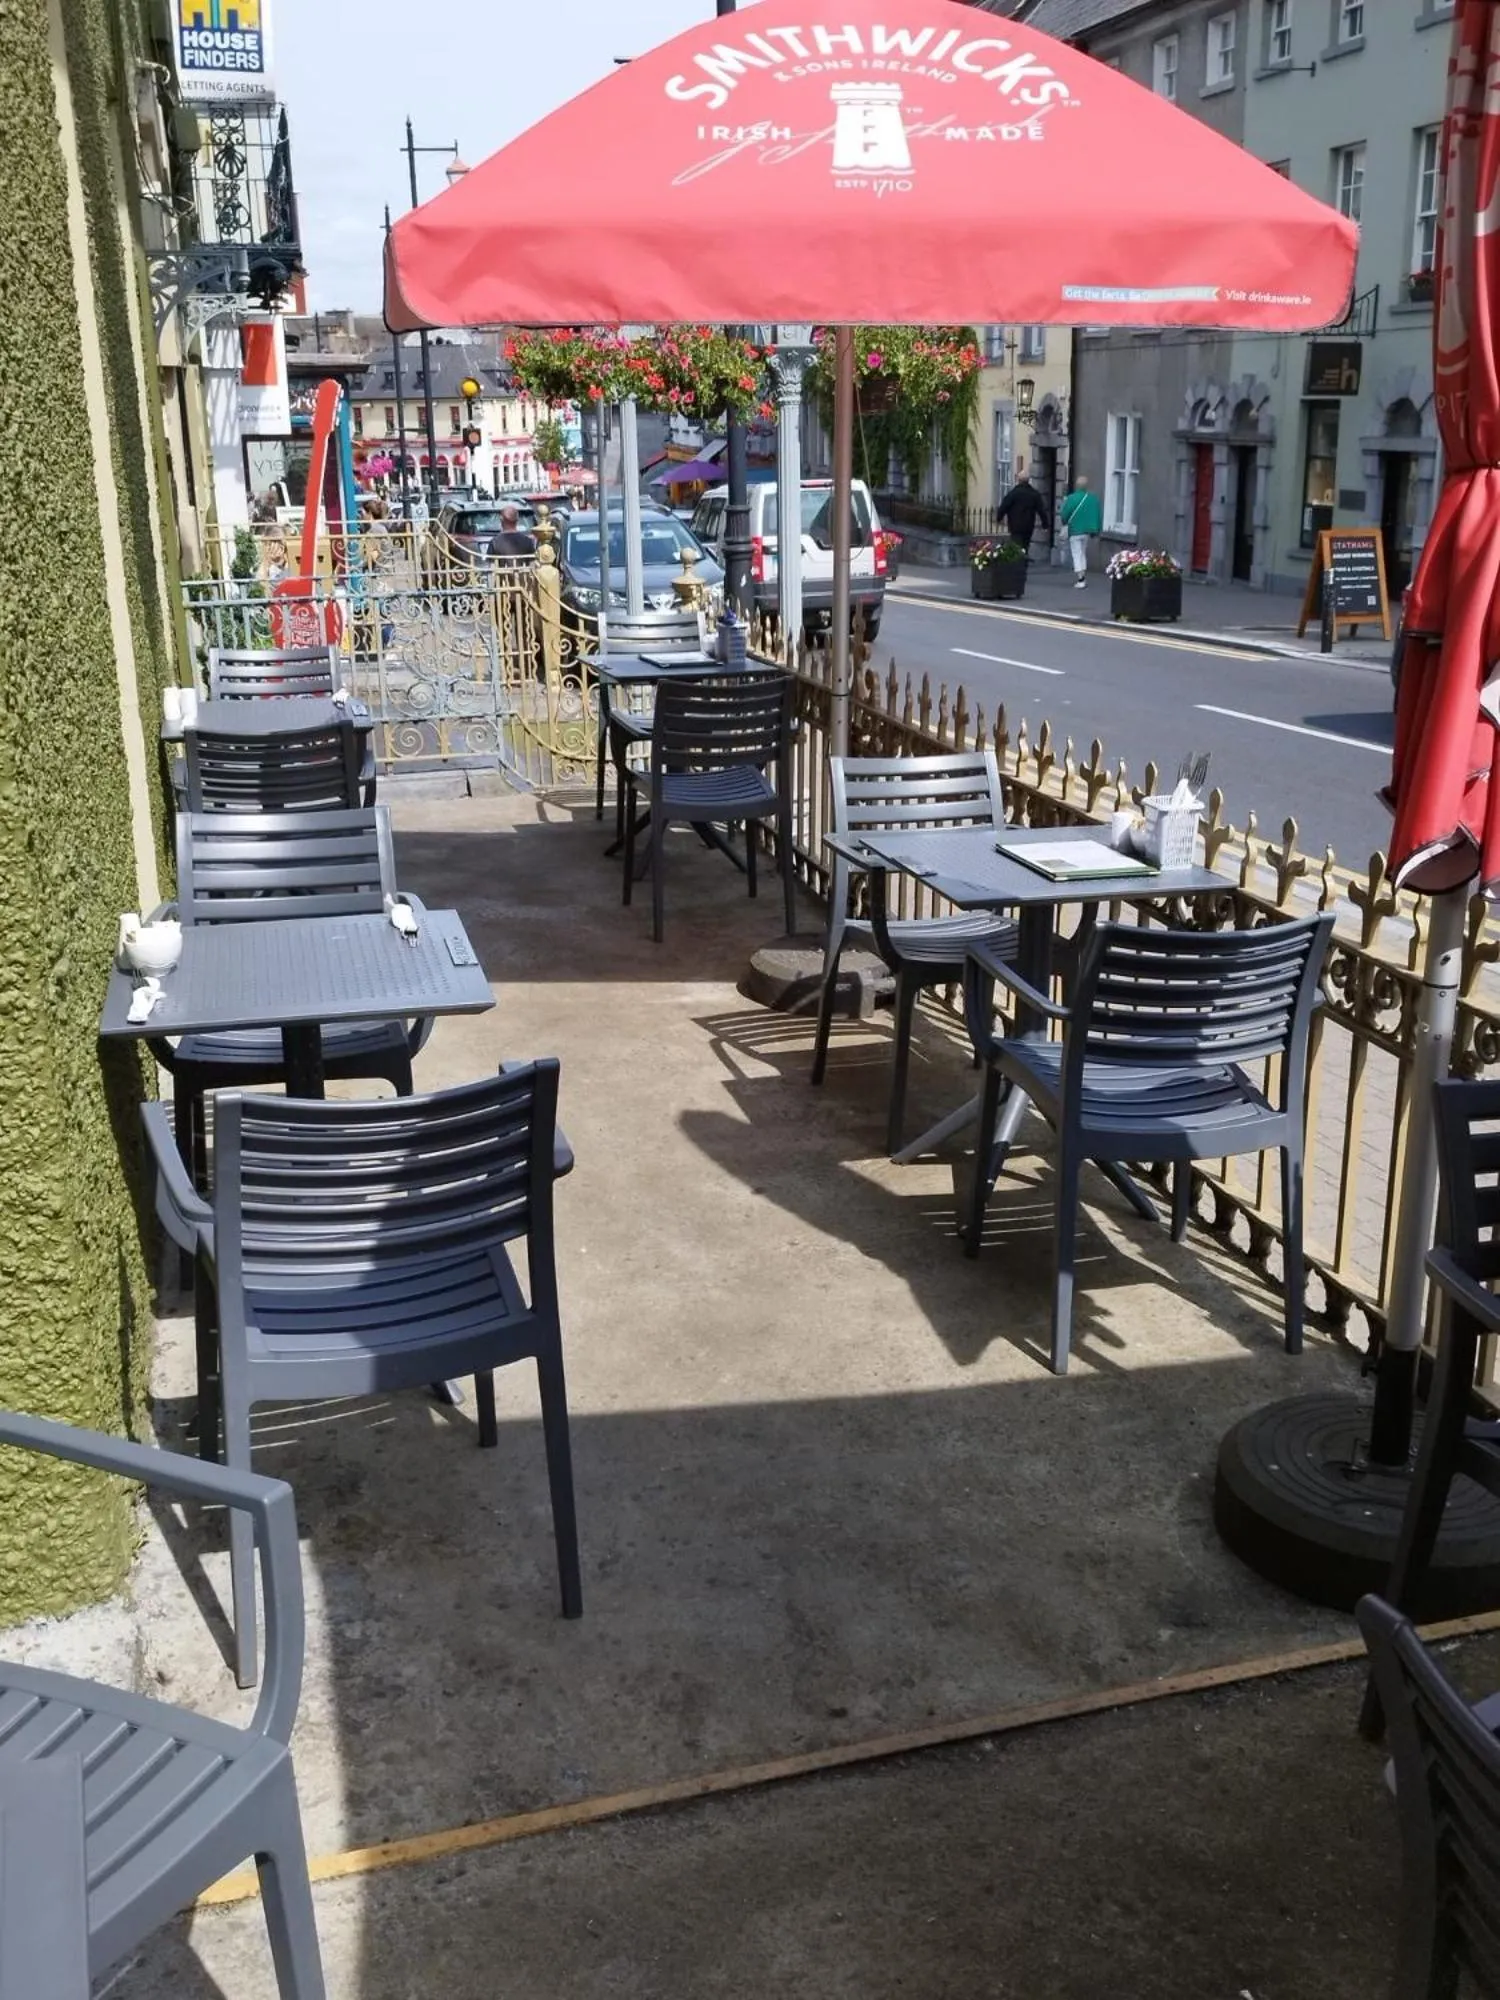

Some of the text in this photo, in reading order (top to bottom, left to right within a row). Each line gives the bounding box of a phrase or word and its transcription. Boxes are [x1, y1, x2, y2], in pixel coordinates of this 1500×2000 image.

[182, 30, 259, 51] HOUSE
[183, 49, 261, 70] FINDERS
[792, 58, 854, 76] SONS
[861, 58, 958, 84] IRELAND
[181, 80, 266, 94] LETTING AGENTS
[697, 125, 791, 141] IRISH
[944, 125, 1045, 141] MADE
[873, 179, 912, 198] 1710
